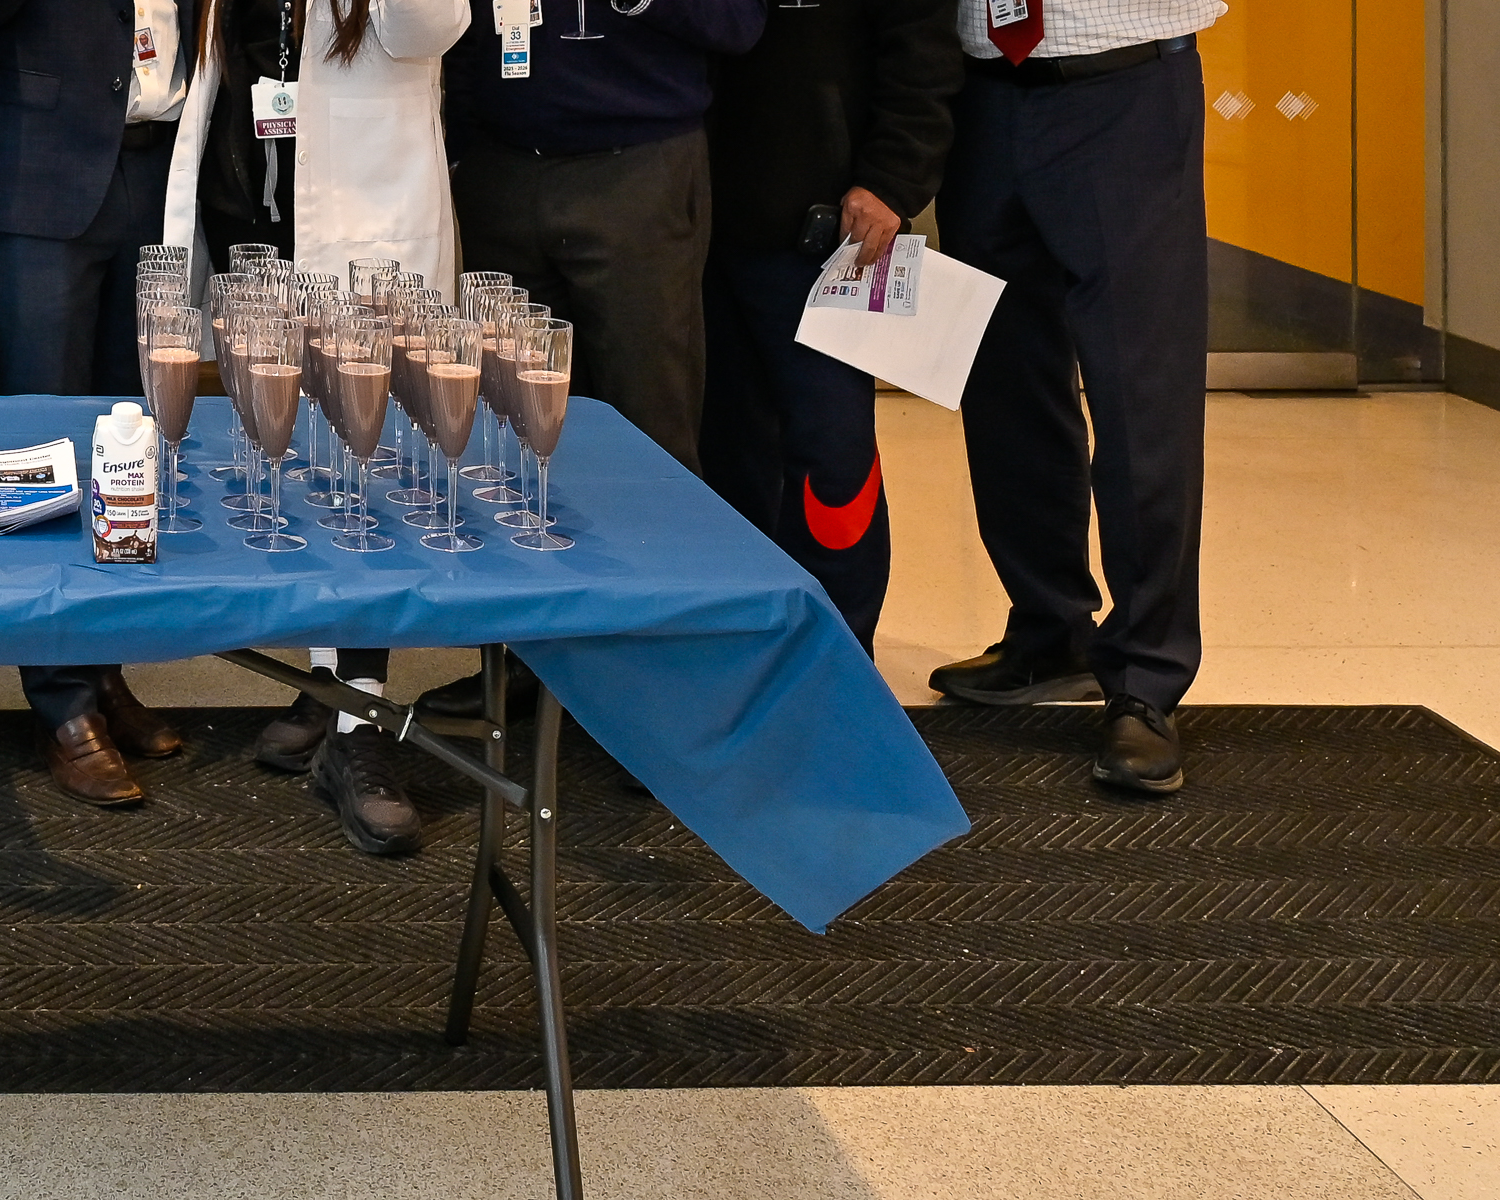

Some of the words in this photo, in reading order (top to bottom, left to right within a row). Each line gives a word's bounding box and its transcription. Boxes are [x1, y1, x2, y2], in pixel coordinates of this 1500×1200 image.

[510, 31, 521, 40] 33
[262, 121, 297, 129] PHYSICIA
[103, 459, 145, 473] Ensure
